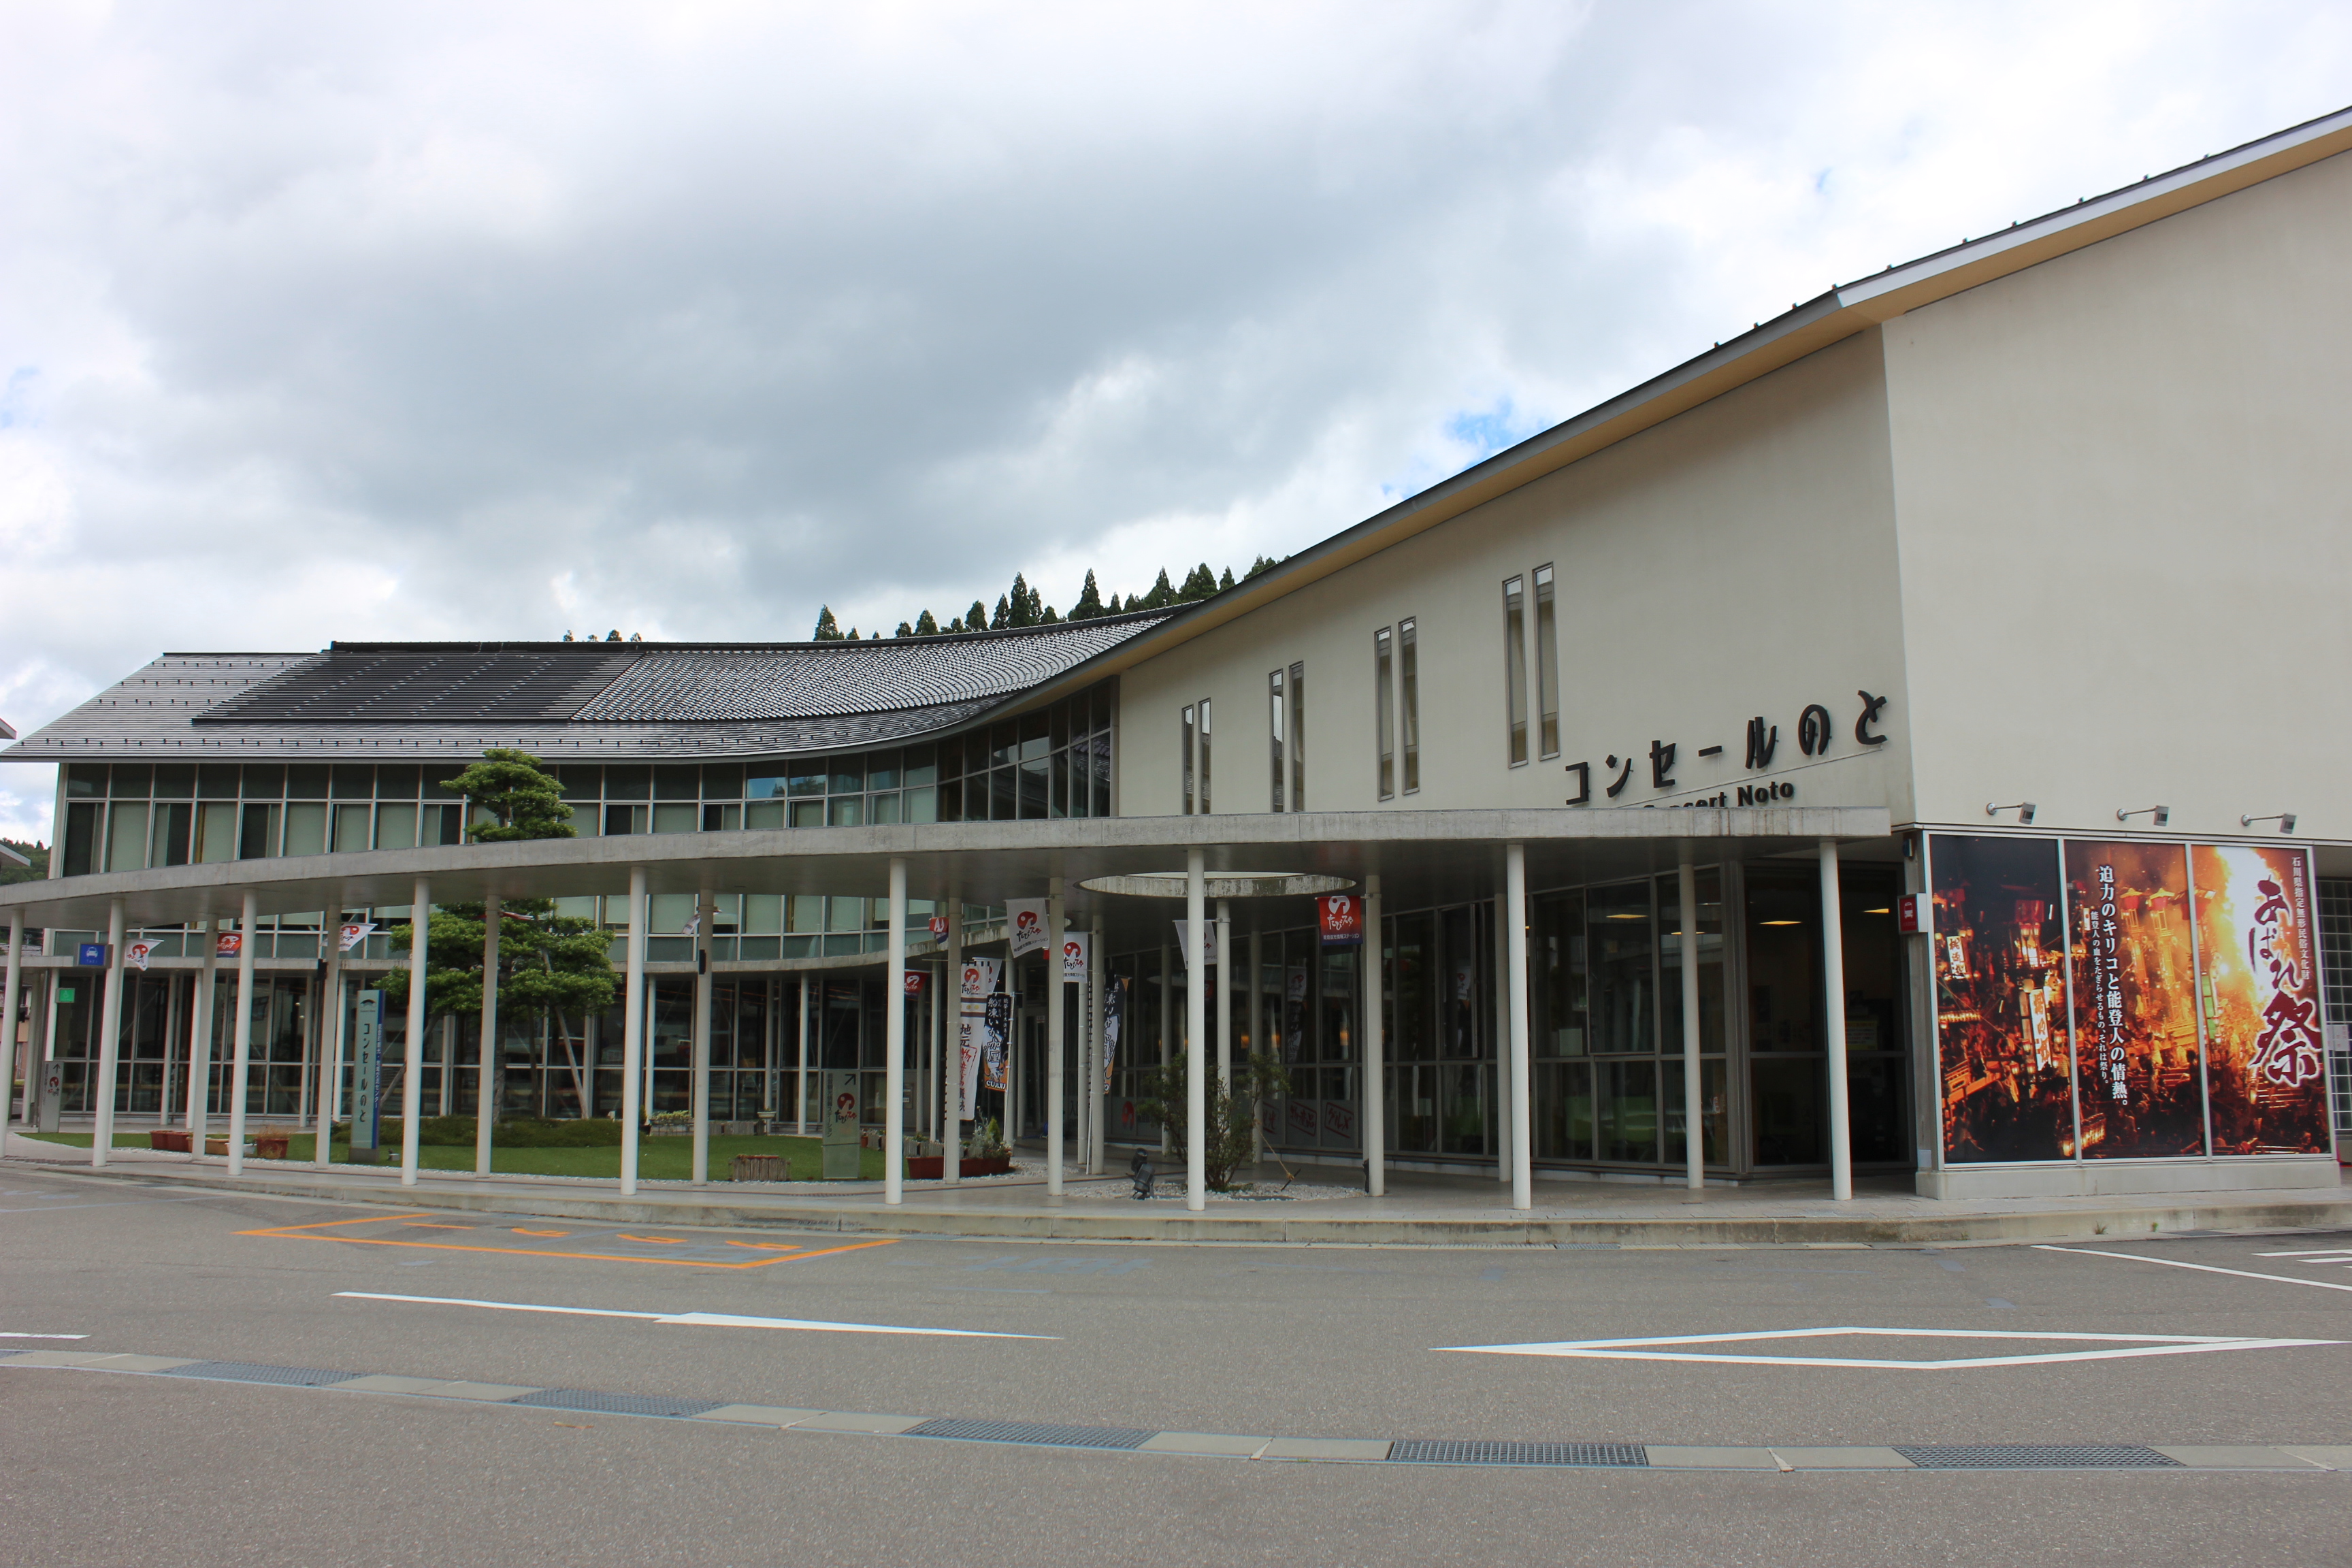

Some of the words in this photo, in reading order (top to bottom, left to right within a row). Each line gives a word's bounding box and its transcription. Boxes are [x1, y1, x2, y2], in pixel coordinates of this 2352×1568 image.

[1565, 690, 1888, 805] コンセールのと
[1737, 781, 1794, 807] Noto
[2091, 911, 2109, 1084] 能登人の血をたぎらせるもの、それは祭り。
[2098, 865, 2128, 1106] 迫力のキリコと能登人の情熱。
[2249, 874, 2322, 1085] あばれ祭
[359, 1023, 370, 1122] コンセールのと
